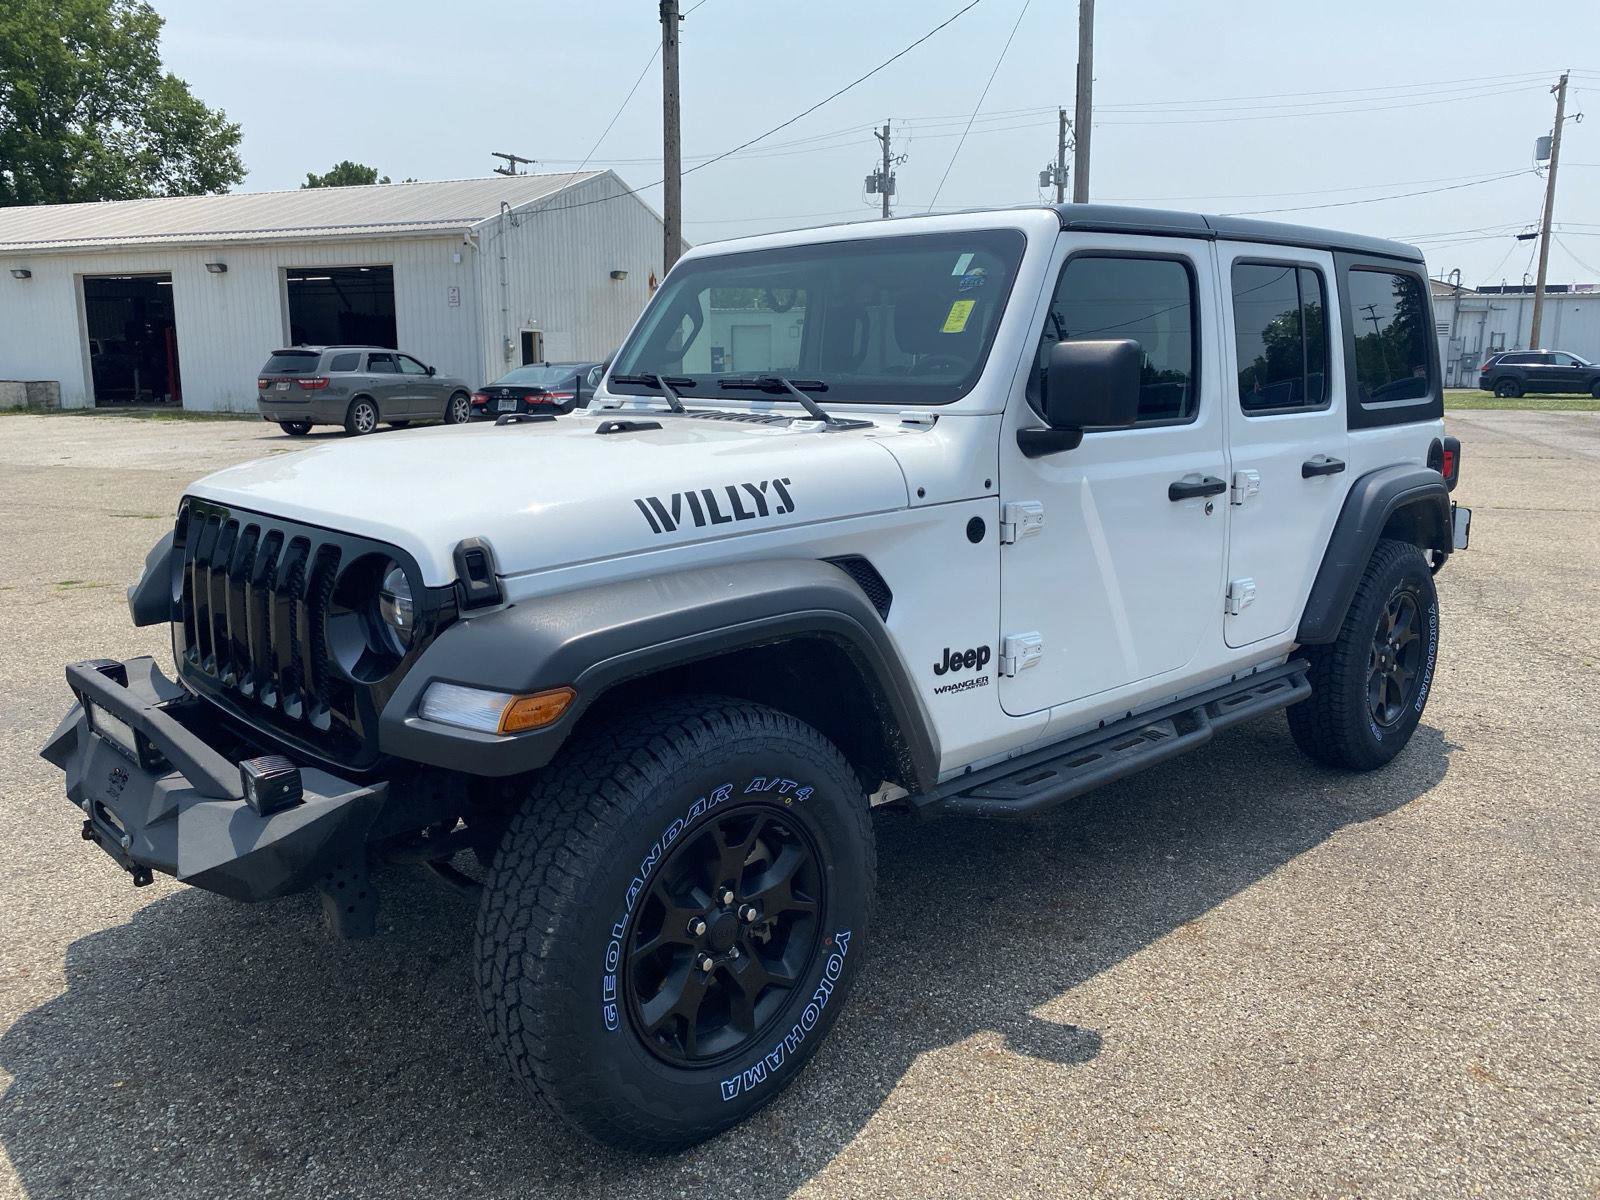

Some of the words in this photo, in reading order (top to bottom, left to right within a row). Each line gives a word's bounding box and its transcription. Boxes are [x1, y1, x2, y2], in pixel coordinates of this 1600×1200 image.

[634, 477, 795, 534] WILLYS
[933, 645, 991, 676] Jeep
[934, 676, 989, 695] WRANGLER
[1414, 602, 1436, 713] YOKOHAMA
[603, 784, 734, 1031] GEOLANDAR
[720, 929, 851, 1101] YOKOHAMA
